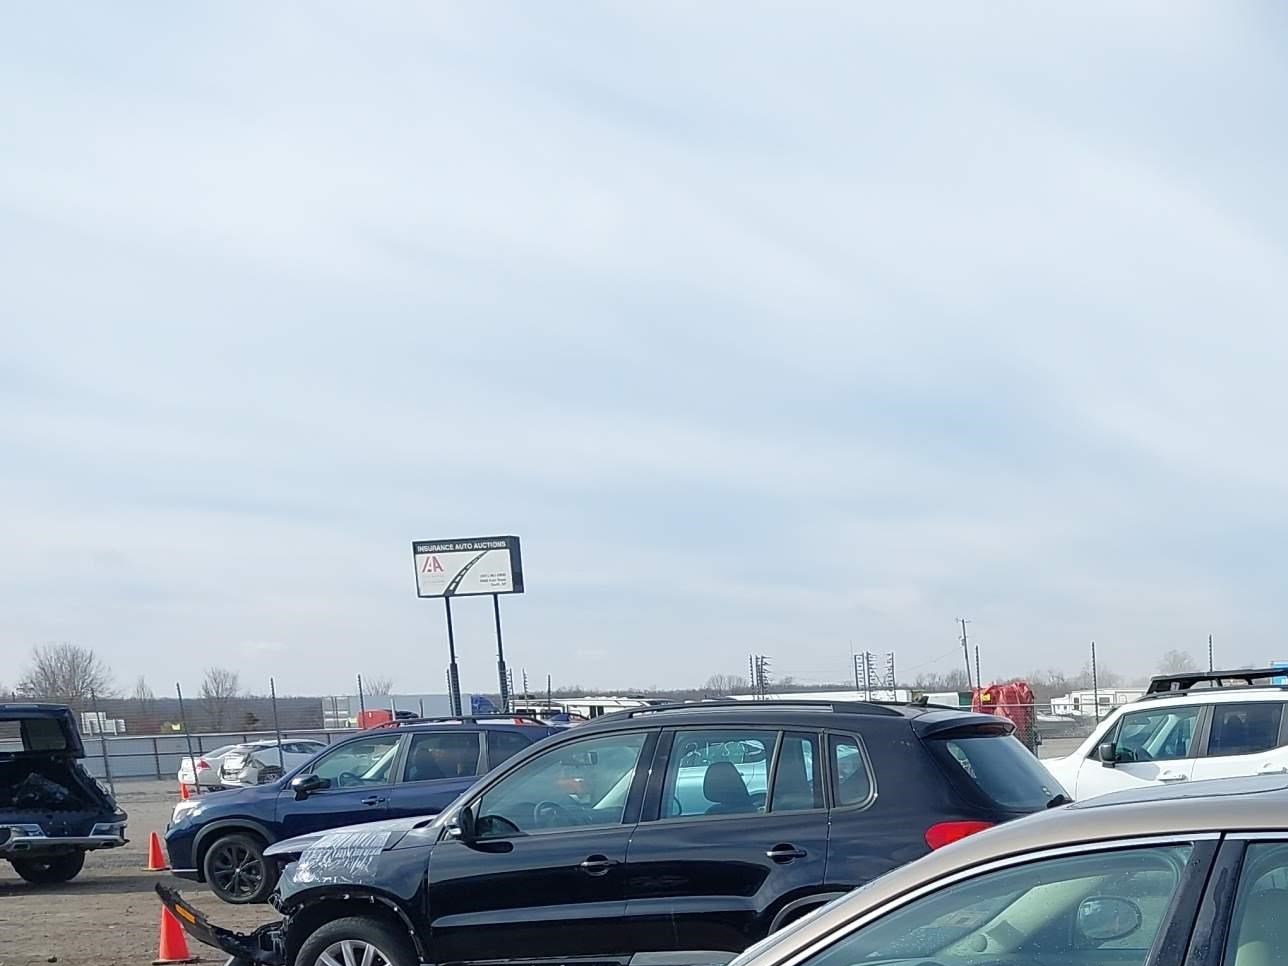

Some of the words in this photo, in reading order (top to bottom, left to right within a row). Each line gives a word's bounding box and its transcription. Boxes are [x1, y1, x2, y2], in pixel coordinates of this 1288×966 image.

[417, 544, 454, 552] INSURANCE
[455, 542, 473, 550] AUTO
[473, 541, 506, 549] AUCTIONS
